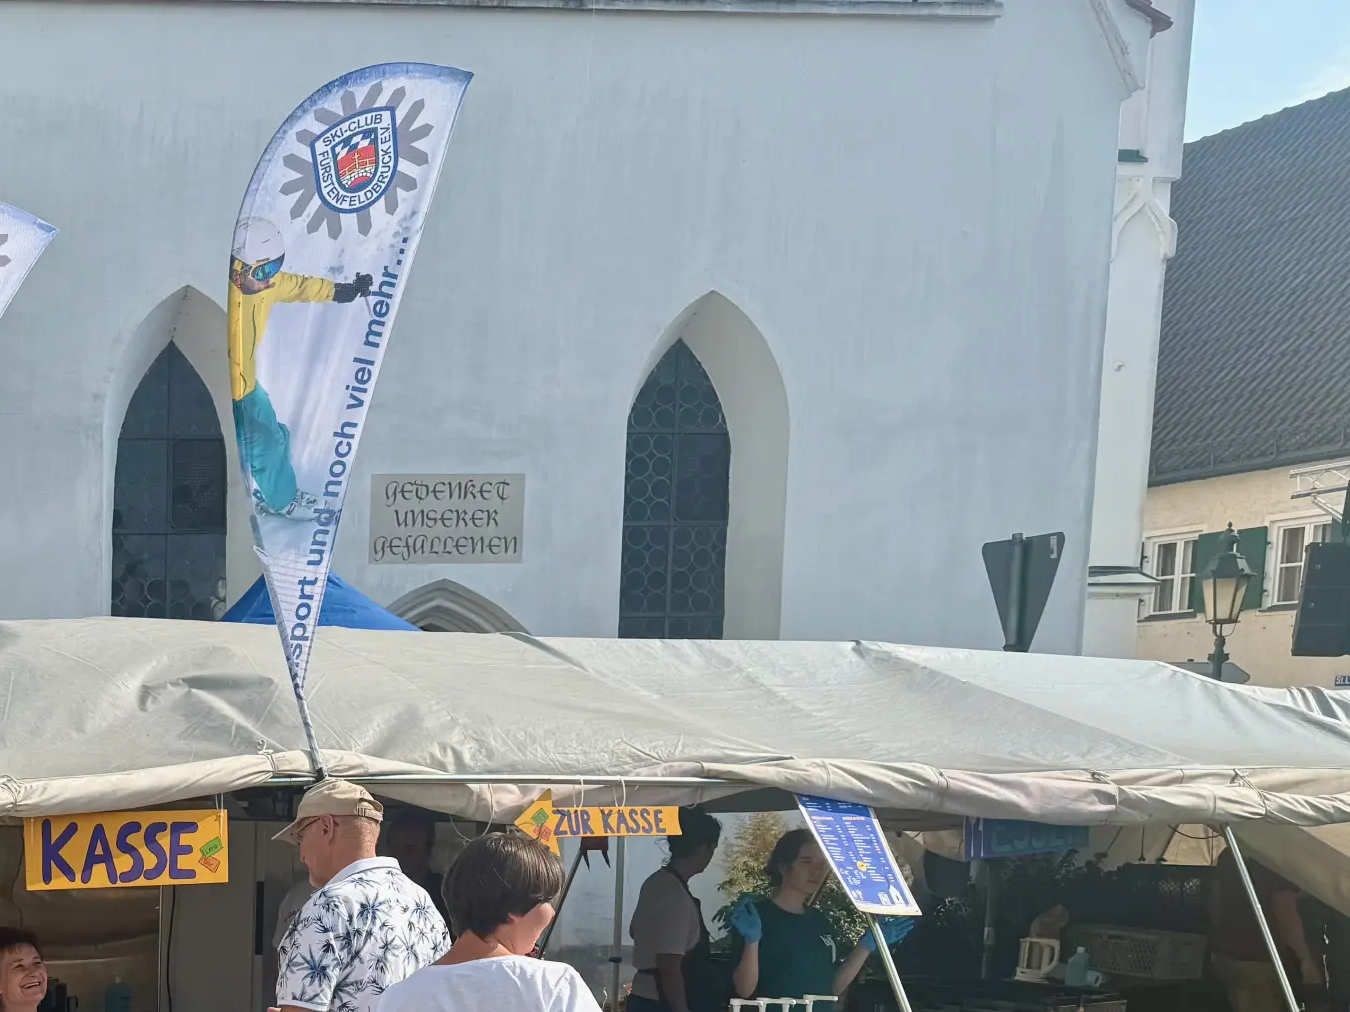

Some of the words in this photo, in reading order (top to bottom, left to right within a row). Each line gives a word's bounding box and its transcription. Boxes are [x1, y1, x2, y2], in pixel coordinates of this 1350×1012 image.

[322, 113, 383, 147] SKI-CLUB
[317, 147, 392, 207] FÜRSTENFELDBRUCK
[306, 508, 335, 566] und
[323, 420, 358, 499] noch
[346, 356, 376, 411] viel
[363, 236, 409, 349] mehr...
[394, 509, 499, 528] UNSERER
[551, 808, 595, 836] ZUR
[599, 807, 667, 834] KASSE
[41, 818, 199, 885] KASSE
